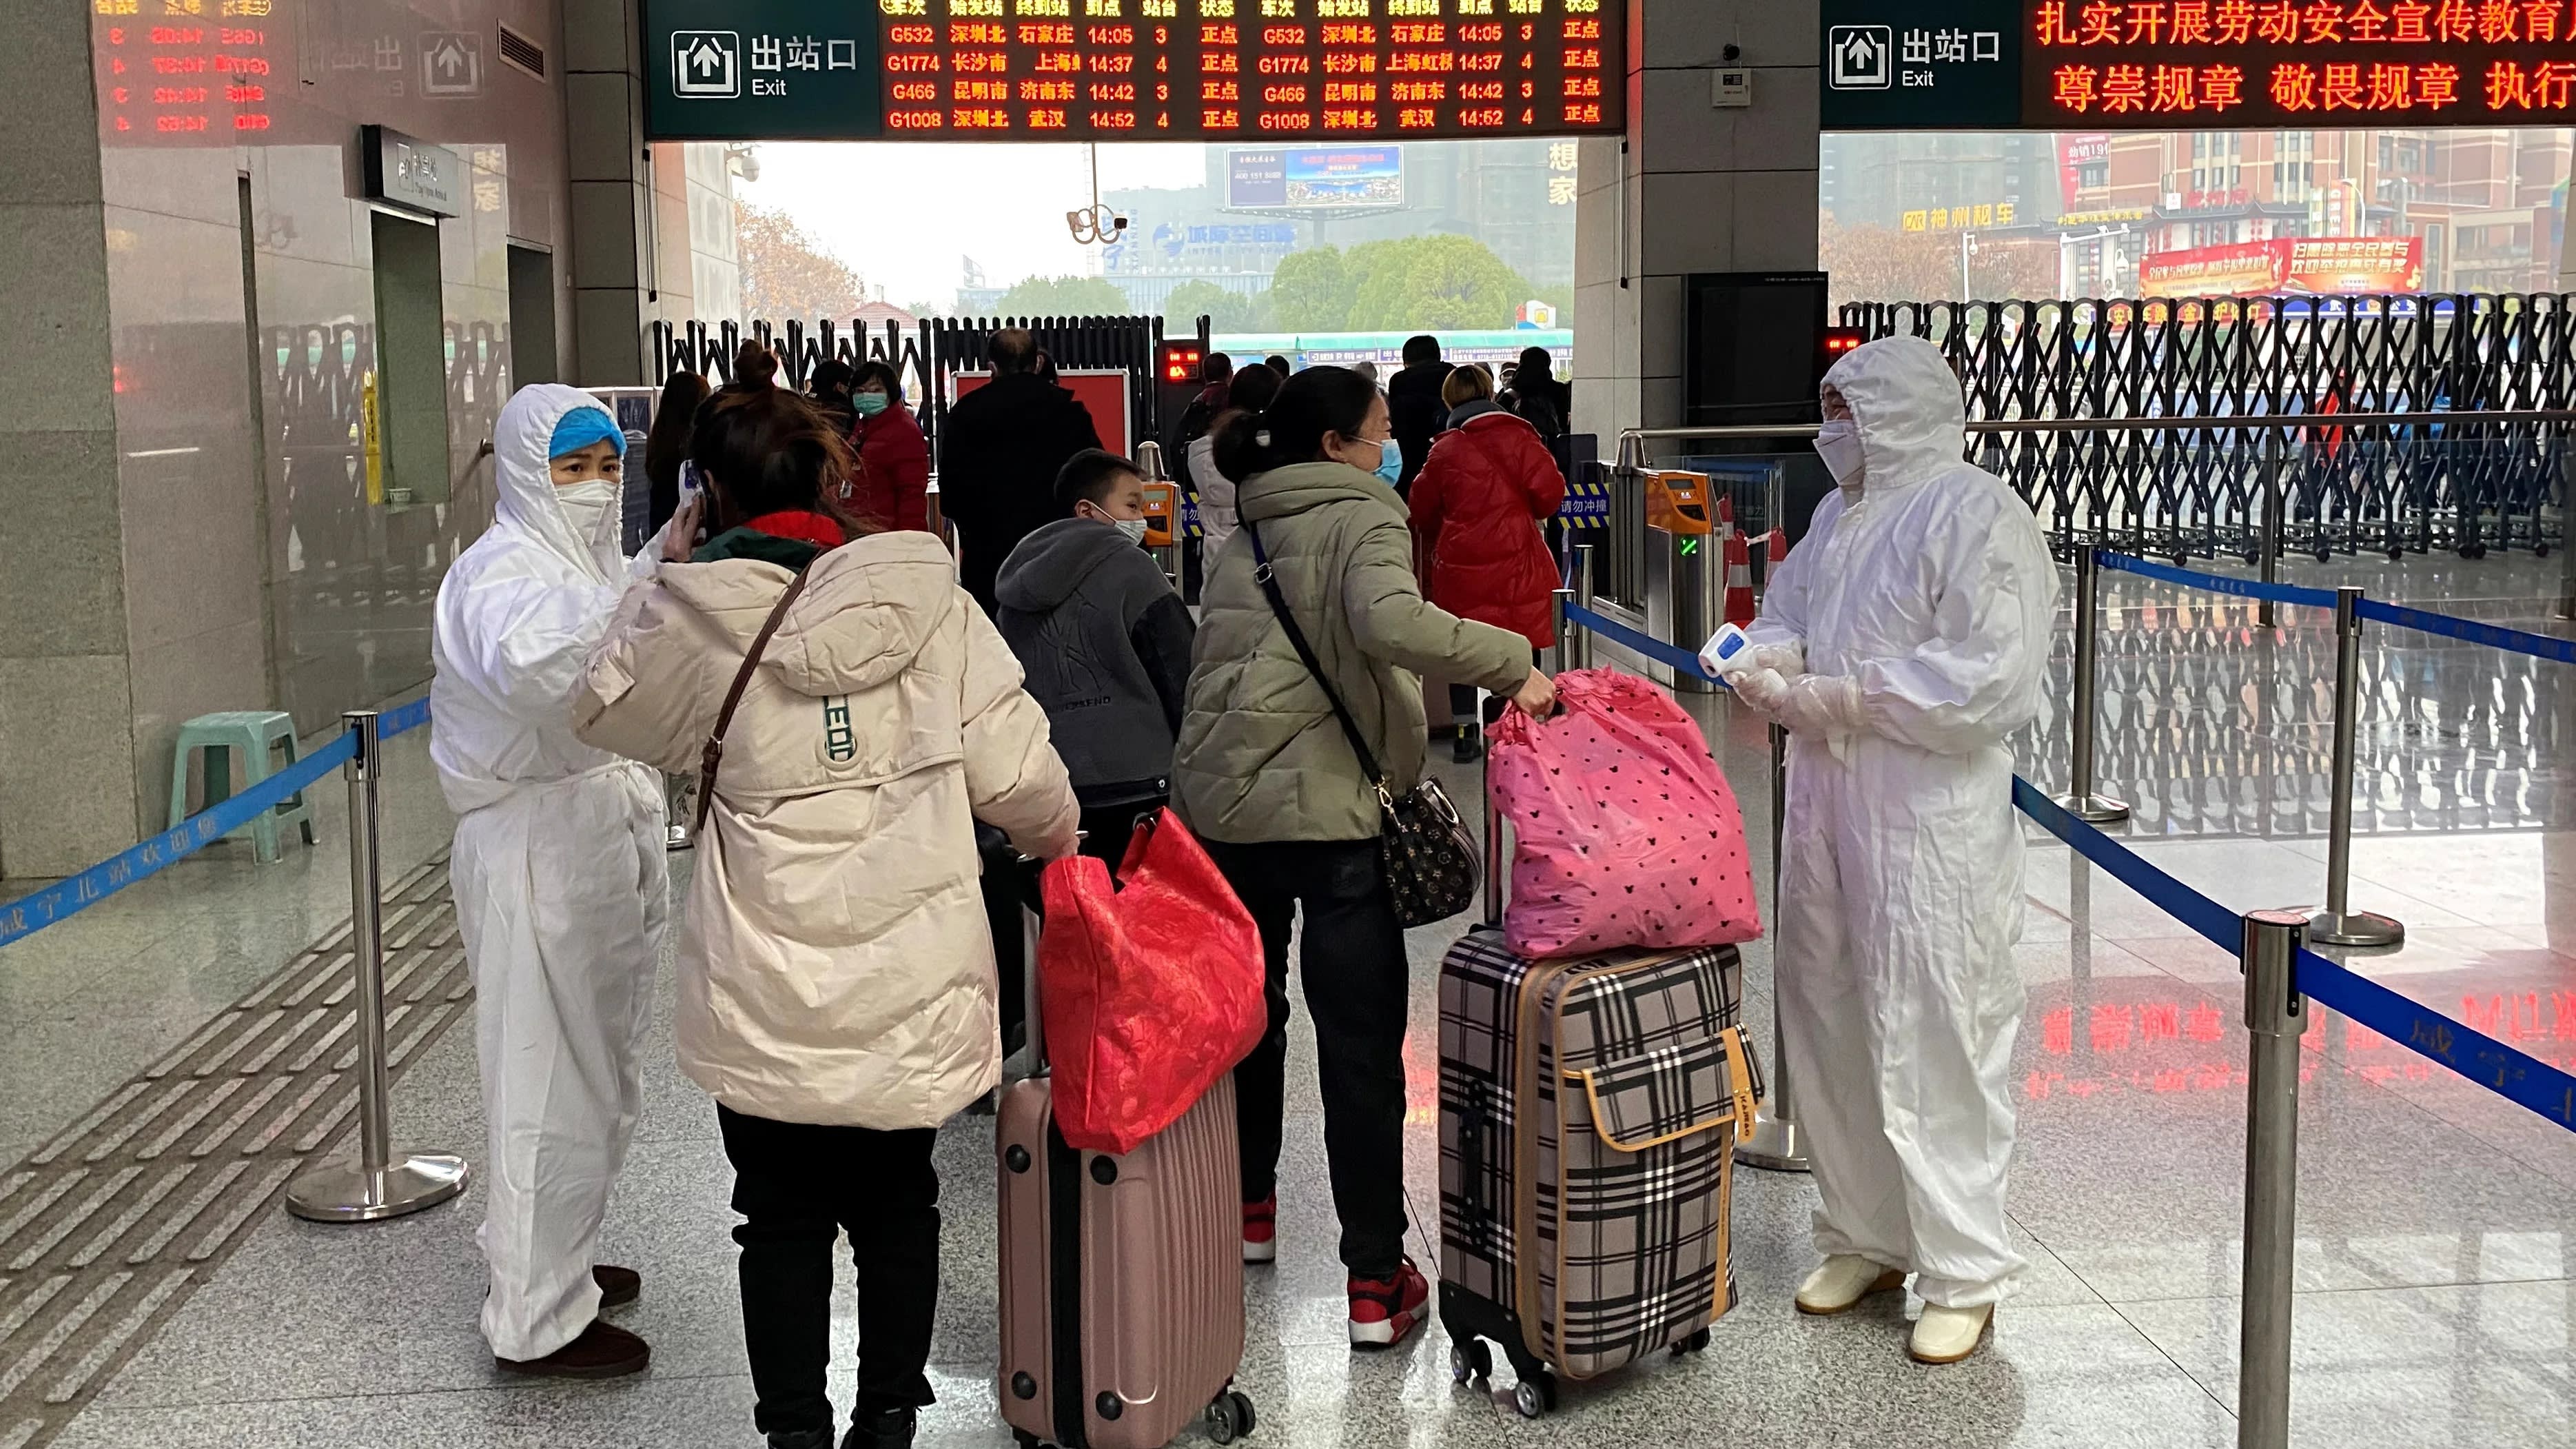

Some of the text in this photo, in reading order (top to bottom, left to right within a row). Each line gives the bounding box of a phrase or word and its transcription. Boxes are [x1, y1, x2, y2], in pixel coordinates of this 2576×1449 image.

[950, 0, 1003, 17] 始发站
[1016, 0, 1070, 17] 终到站
[1085, 0, 1121, 17] 到点
[1143, 0, 1176, 17] 站台
[1200, 0, 1235, 17] 状态
[1261, 0, 1296, 17] 车次
[1317, 0, 1369, 17] 始发站
[1264, 20, 1599, 44] G532 深圳北 石家庄 14:05 3 正点
[2036, 0, 2576, 45] 扎实开展劳动安全宣传教育
[891, 24, 1238, 43] G532 深圳北 石家庄 14:05 3 正点
[752, 35, 857, 72] 出站口
[1902, 29, 2001, 64] 出站口
[888, 55, 940, 72] G1774
[952, 53, 1007, 72] 长沙南
[1089, 56, 1134, 72] 14:37
[1156, 56, 1167, 72] 4
[1202, 53, 1238, 72] 正点
[1259, 57, 1309, 74] G1774
[1322, 54, 1376, 72] 长沙南
[1459, 54, 1502, 70] 14:37
[1521, 54, 1532, 69] 4
[1564, 50, 1599, 68] 正点
[753, 79, 786, 97] Exit
[1902, 69, 1934, 87] Exit
[2054, 61, 2576, 113] 尊崇规章 敬畏规章 执行
[893, 81, 1238, 101] G466 昆明南 济南东 14:42 3 正点
[1265, 78, 1599, 102] G466 昆明南 济南东 14:42 3 正点
[890, 109, 1239, 128] G1008 深圳北 武汉 14:52 4 正点
[1260, 114, 1309, 130] G1008
[1323, 110, 1378, 128] 深圳北
[1400, 108, 1435, 127] 武汉
[1522, 108, 1533, 124] 4
[1564, 104, 1600, 123] 正点
[1548, 142, 1577, 205] 想家
[1930, 203, 2014, 230] 神州租车
[2293, 242, 2410, 258] 扫黑除恶全民参与
[2289, 259, 2407, 274] 欢迎举报查实有奖
[1561, 499, 1608, 513] 请勿冲撞
